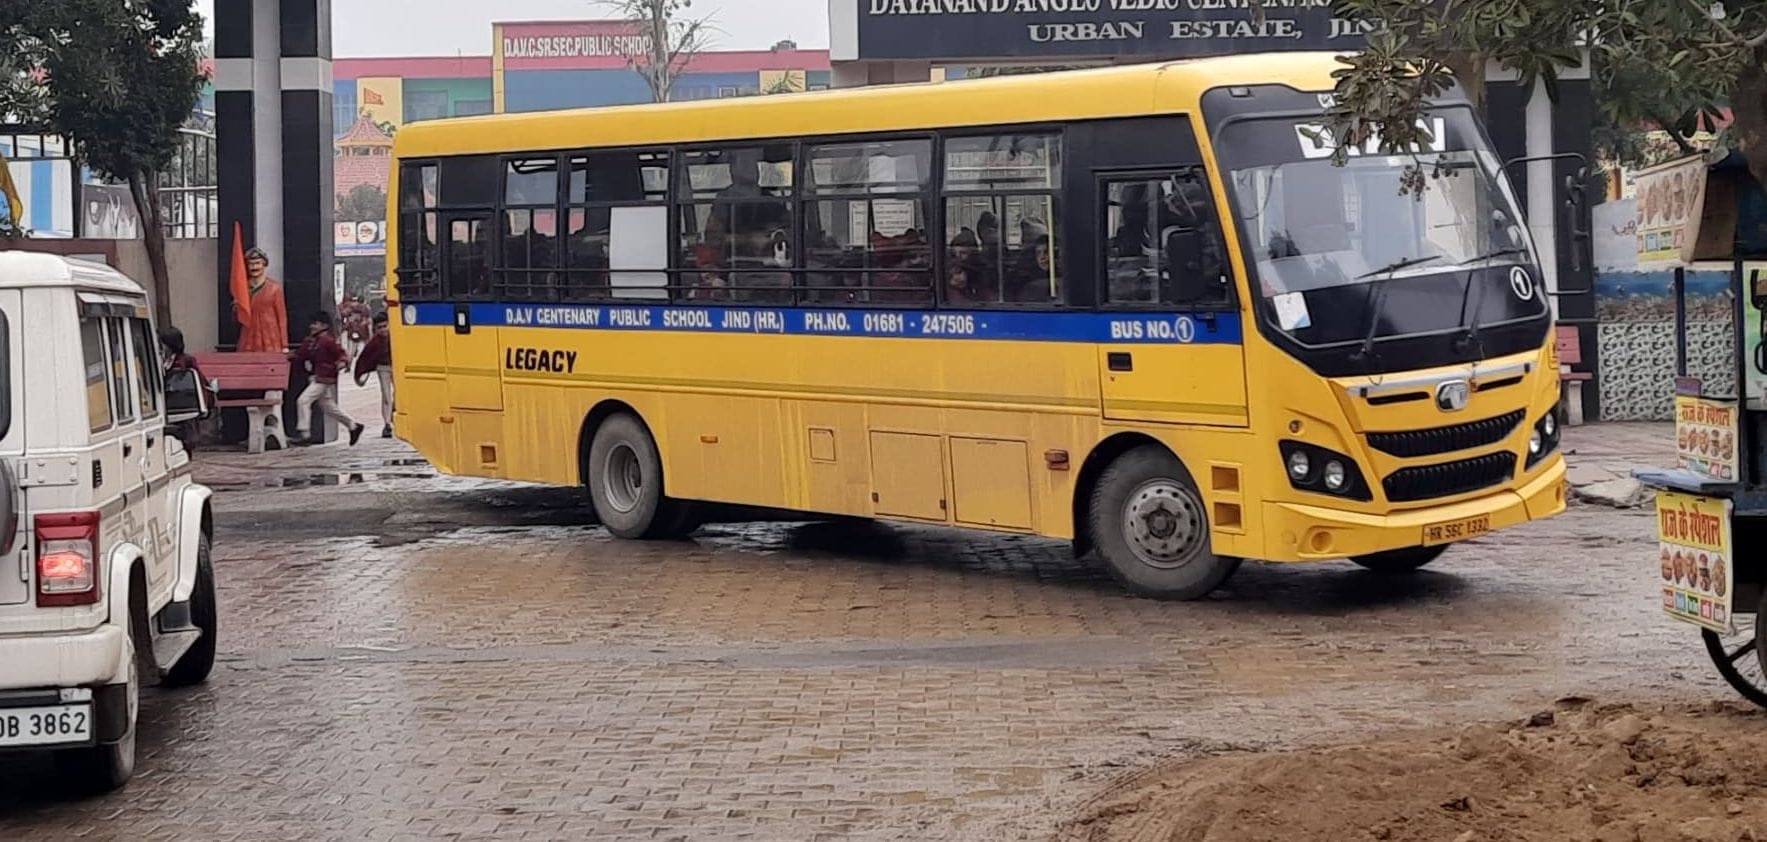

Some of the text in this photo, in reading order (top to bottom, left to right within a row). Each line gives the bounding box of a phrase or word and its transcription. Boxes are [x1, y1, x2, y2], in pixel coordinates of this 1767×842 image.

[869, 0, 1009, 15] DAYANAND
[1027, 22, 1146, 42] URBAN
[1169, 20, 1303, 40] ESTATE,
[506, 307, 533, 324] D.A.V
[536, 308, 600, 326] CENTENARY
[609, 310, 651, 327] PUBLIC
[662, 311, 712, 329] SCHOOL
[721, 311, 750, 329] JIND
[753, 311, 785, 333] (HR.)
[804, 312, 850, 331] PH.NO.
[863, 313, 904, 332] 01681
[921, 314, 975, 334] 247506
[1110, 320, 1144, 339] BUS
[505, 346, 577, 374] LEGACY
[29, 711, 87, 736] 3862
